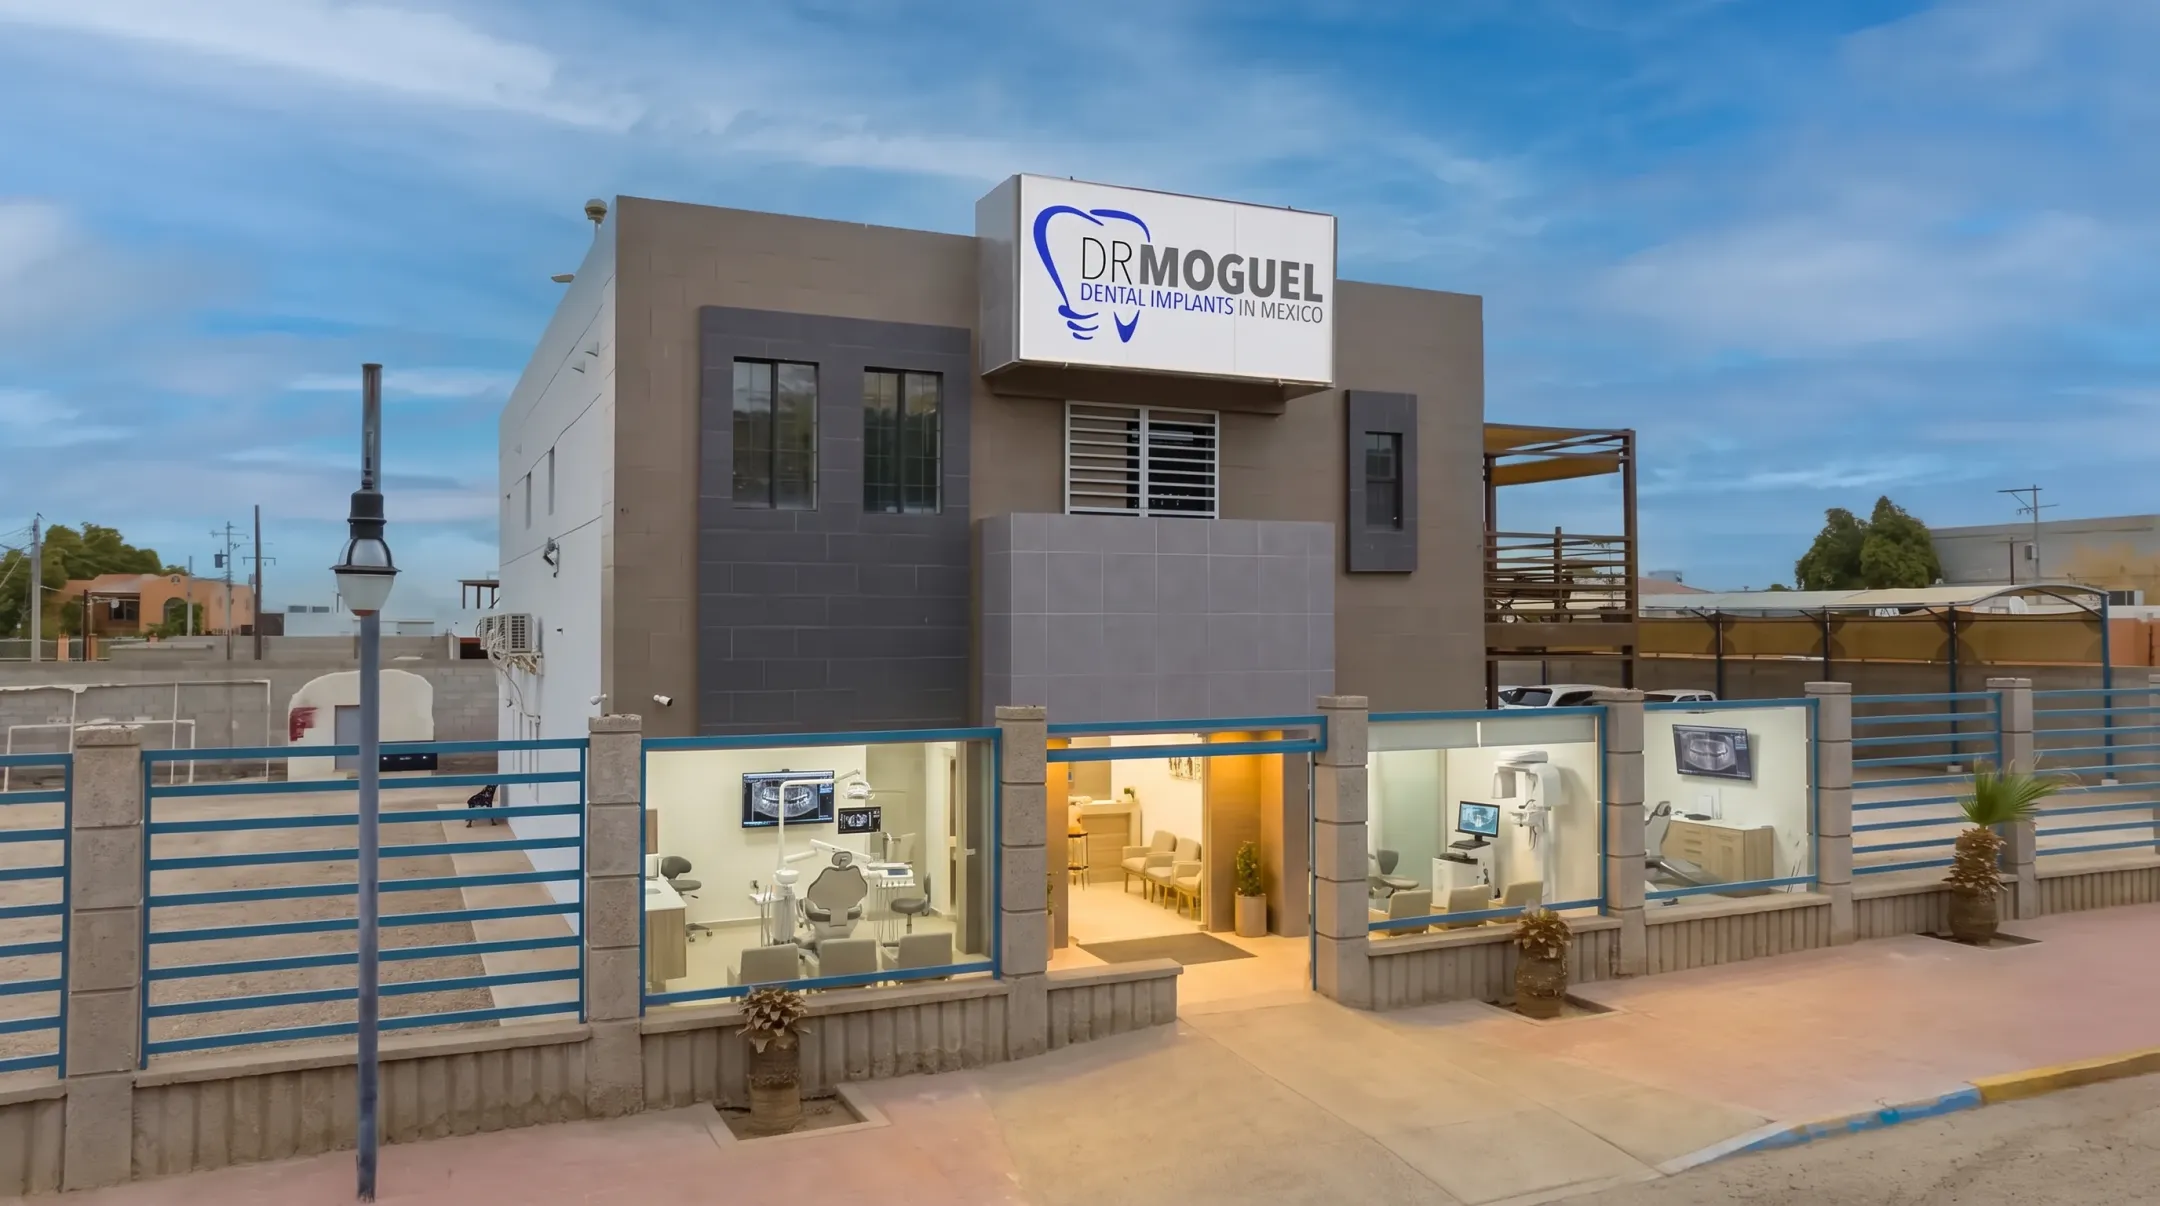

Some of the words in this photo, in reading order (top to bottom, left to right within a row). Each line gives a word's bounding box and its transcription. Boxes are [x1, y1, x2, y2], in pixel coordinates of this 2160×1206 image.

[1080, 282, 1147, 307] DENTAL
[1150, 289, 1234, 316] IMPLANTS
[1239, 298, 1255, 317] IN
[1261, 301, 1323, 324] MEXICO
